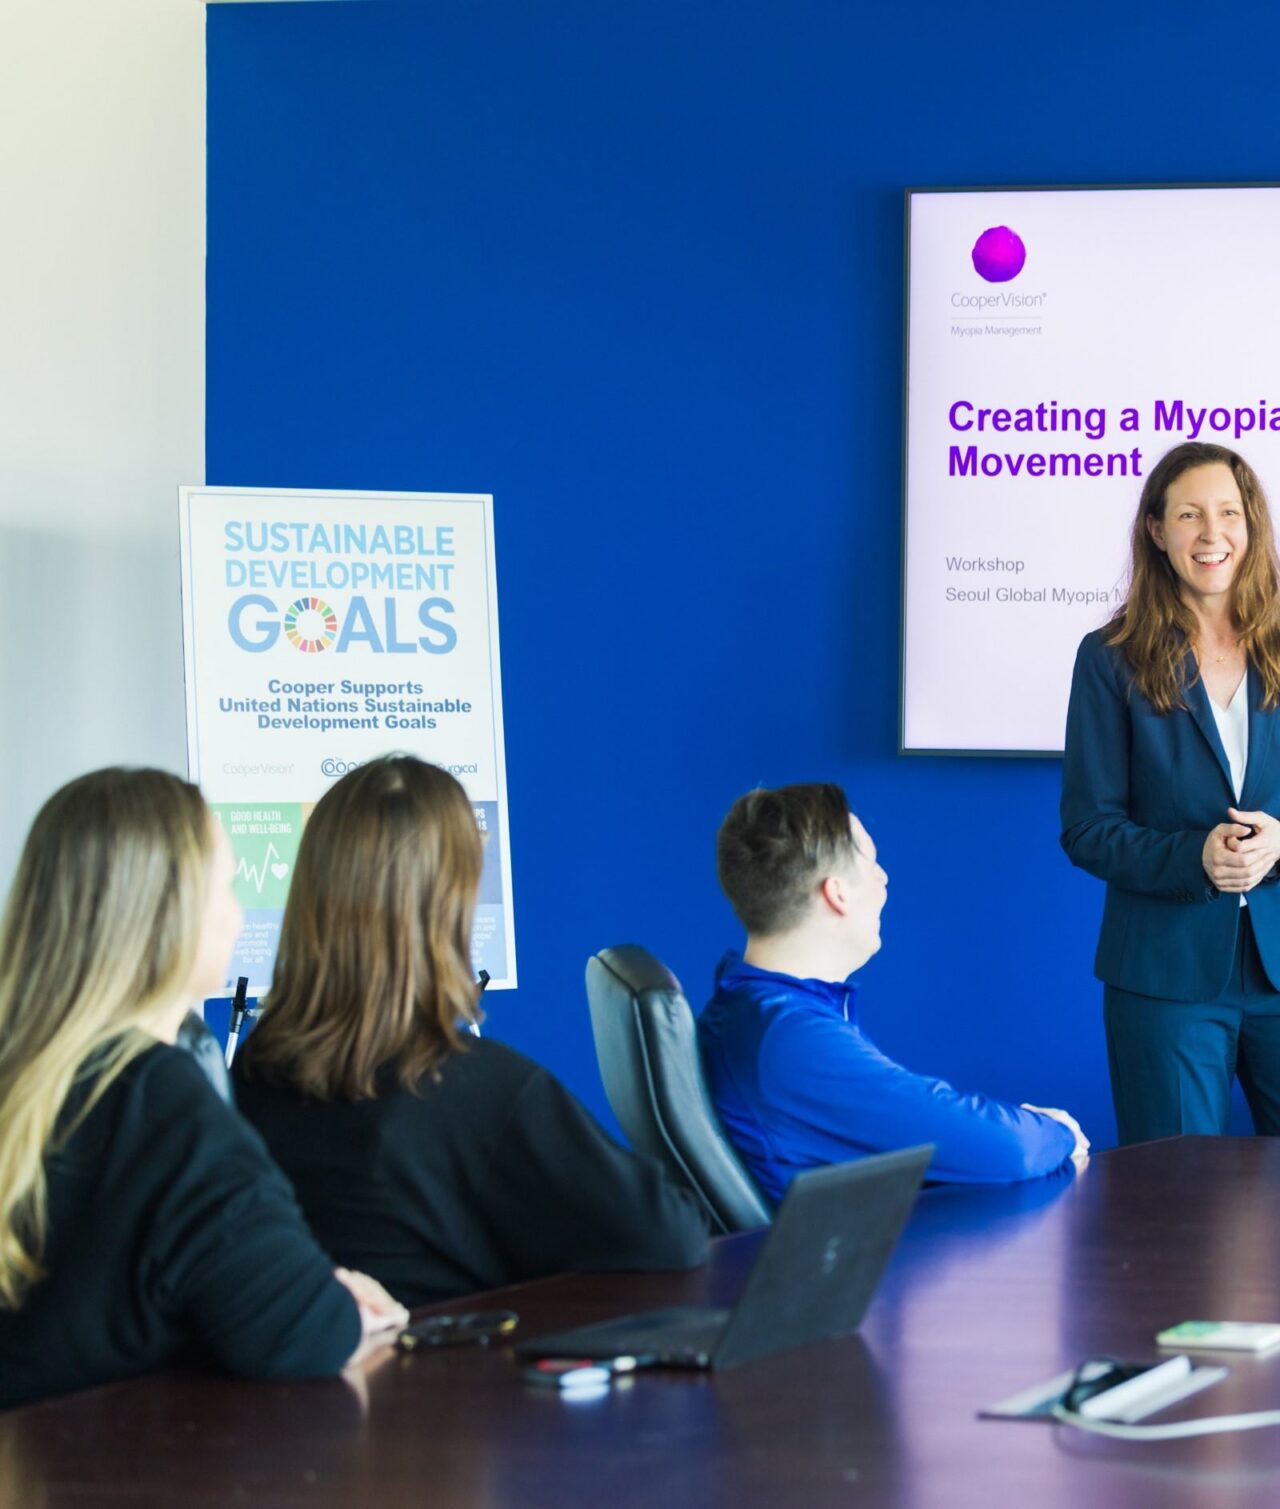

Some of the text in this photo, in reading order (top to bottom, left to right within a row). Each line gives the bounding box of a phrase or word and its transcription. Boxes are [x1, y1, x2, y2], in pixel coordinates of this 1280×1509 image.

[951, 325, 1042, 337] Myopia Management
[949, 401, 1105, 440] Creating
[1120, 408, 1139, 431] a
[949, 446, 1142, 477] Movement
[225, 521, 455, 556] SUSTAINABLE
[946, 557, 1024, 574] Workshop
[226, 560, 454, 591] DEVELOPMENT
[946, 587, 989, 601] Seoul
[996, 588, 1046, 602] Global
[1052, 588, 1108, 605] Myopia
[228, 594, 457, 655] GOALS
[268, 680, 423, 698] Cooper Supports
[220, 698, 471, 712] United Nations Sustainable
[258, 715, 436, 732] Development Goals
[231, 811, 281, 821] GOOD HEALTH
[232, 823, 292, 834] AND WELL-BEING
